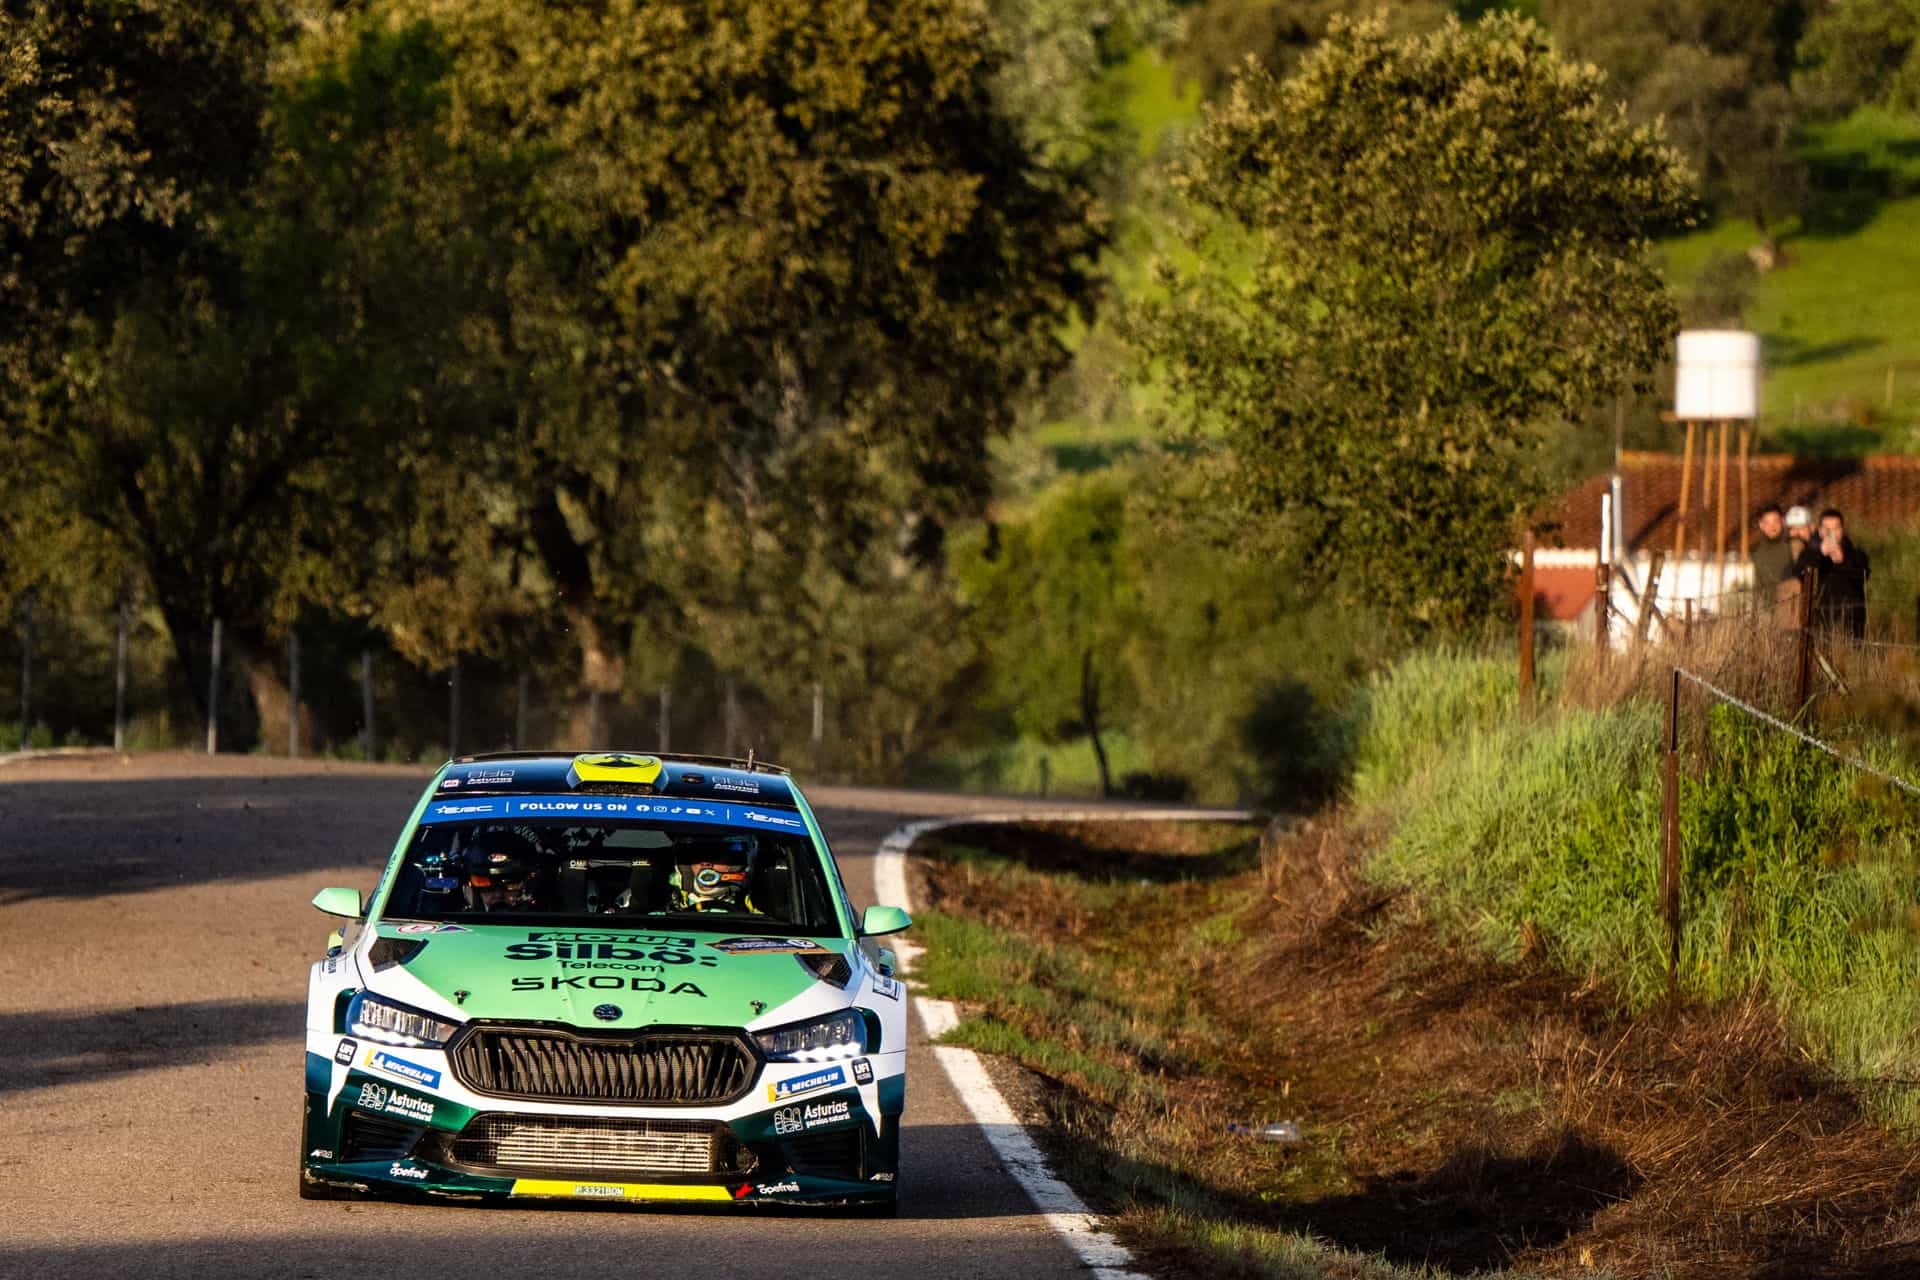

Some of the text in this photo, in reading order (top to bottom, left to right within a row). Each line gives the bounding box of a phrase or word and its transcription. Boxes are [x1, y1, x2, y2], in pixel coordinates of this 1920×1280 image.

[519, 802, 628, 811] FOLLOW US ON
[535, 934, 689, 947] MOTUL
[557, 960, 666, 973] Telecom
[385, 1060, 435, 1083] MICHELIN
[791, 1072, 839, 1092] MICHELIN
[388, 1089, 435, 1114] Asturias
[804, 1101, 848, 1120] Asturias
